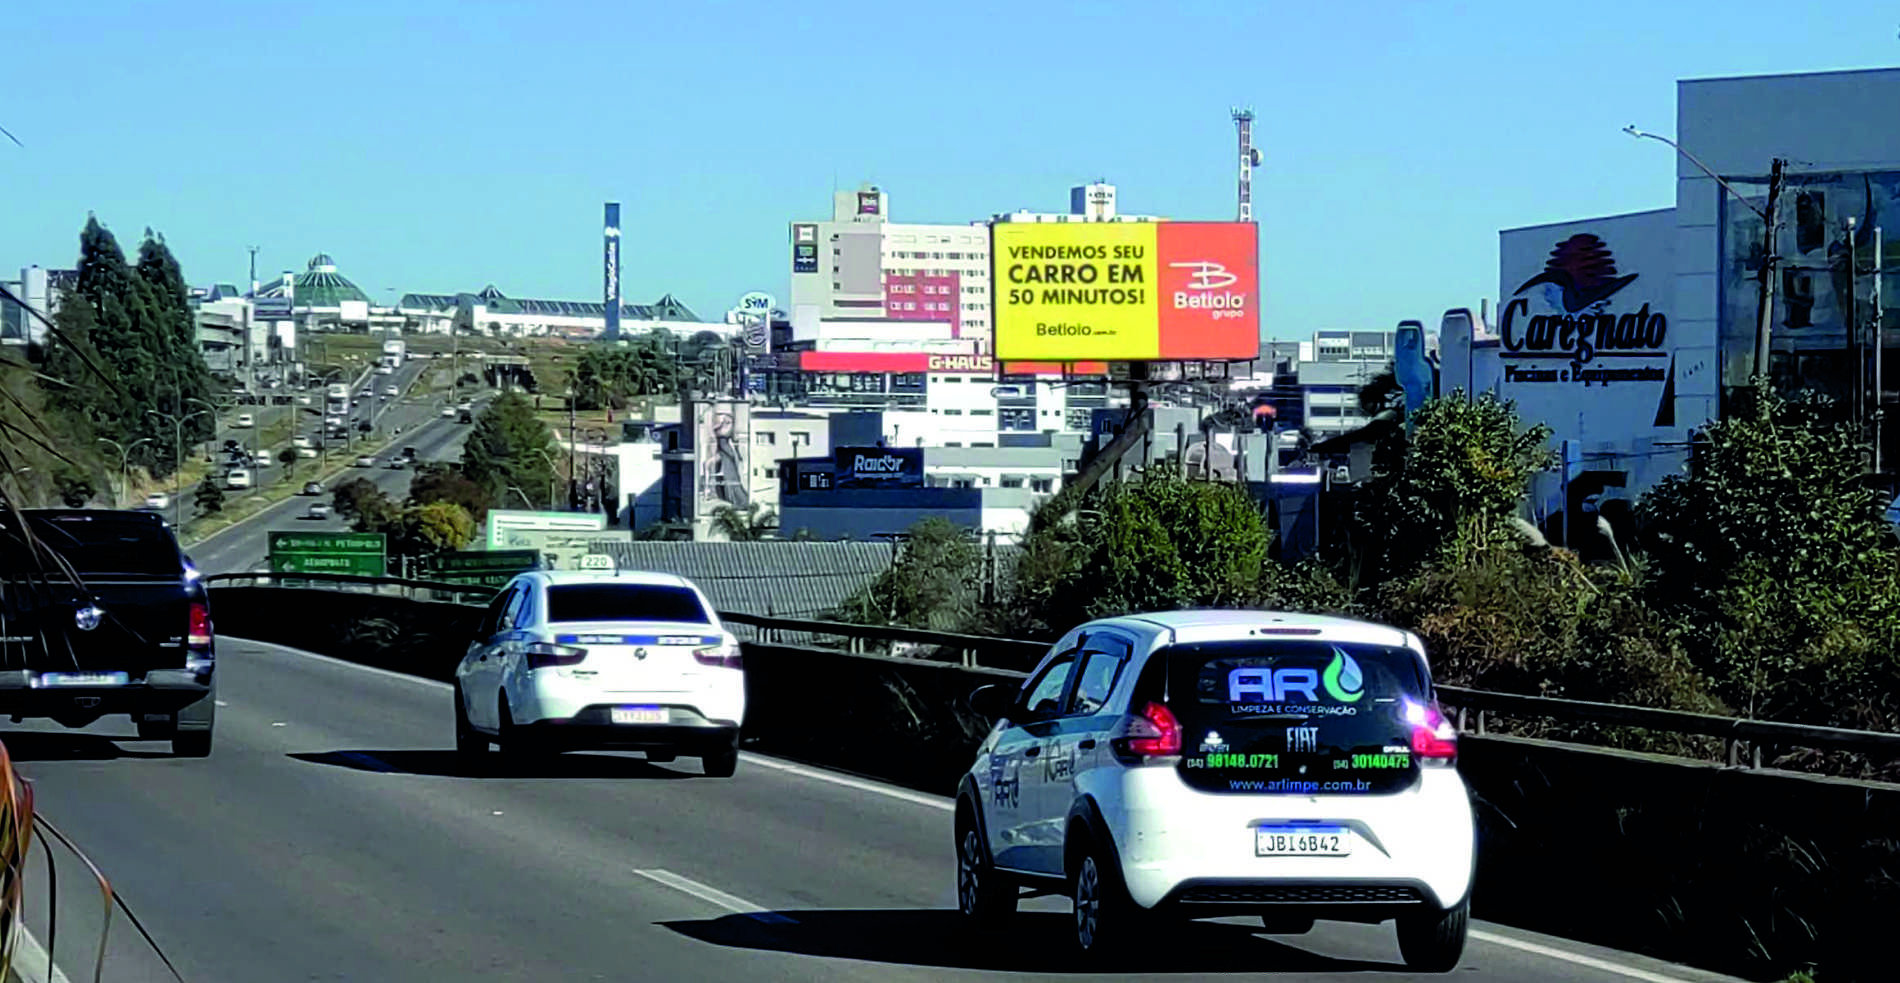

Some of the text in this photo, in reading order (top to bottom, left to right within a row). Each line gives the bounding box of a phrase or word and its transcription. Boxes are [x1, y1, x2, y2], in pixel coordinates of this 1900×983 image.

[1008, 245, 1144, 260] VENDEMOS SEU
[1008, 264, 1144, 284] CARRO EM
[1009, 289, 1145, 305] 50 MINUTOS!
[1174, 292, 1244, 309] Betiolo
[1212, 309, 1243, 320] grupo
[1502, 298, 1667, 363] Caregnato
[928, 356, 993, 370] G-HAUS
[1559, 370, 1569, 383] e
[585, 556, 608, 567] 220
[1231, 704, 1357, 718] LIMPEZA E CONSERVAÇÃO
[1286, 725, 1319, 752] FIAT
[1206, 754, 1278, 768] 98148.0721
[1351, 754, 1410, 768] 30140475
[1266, 835, 1340, 852] JBI6B42
